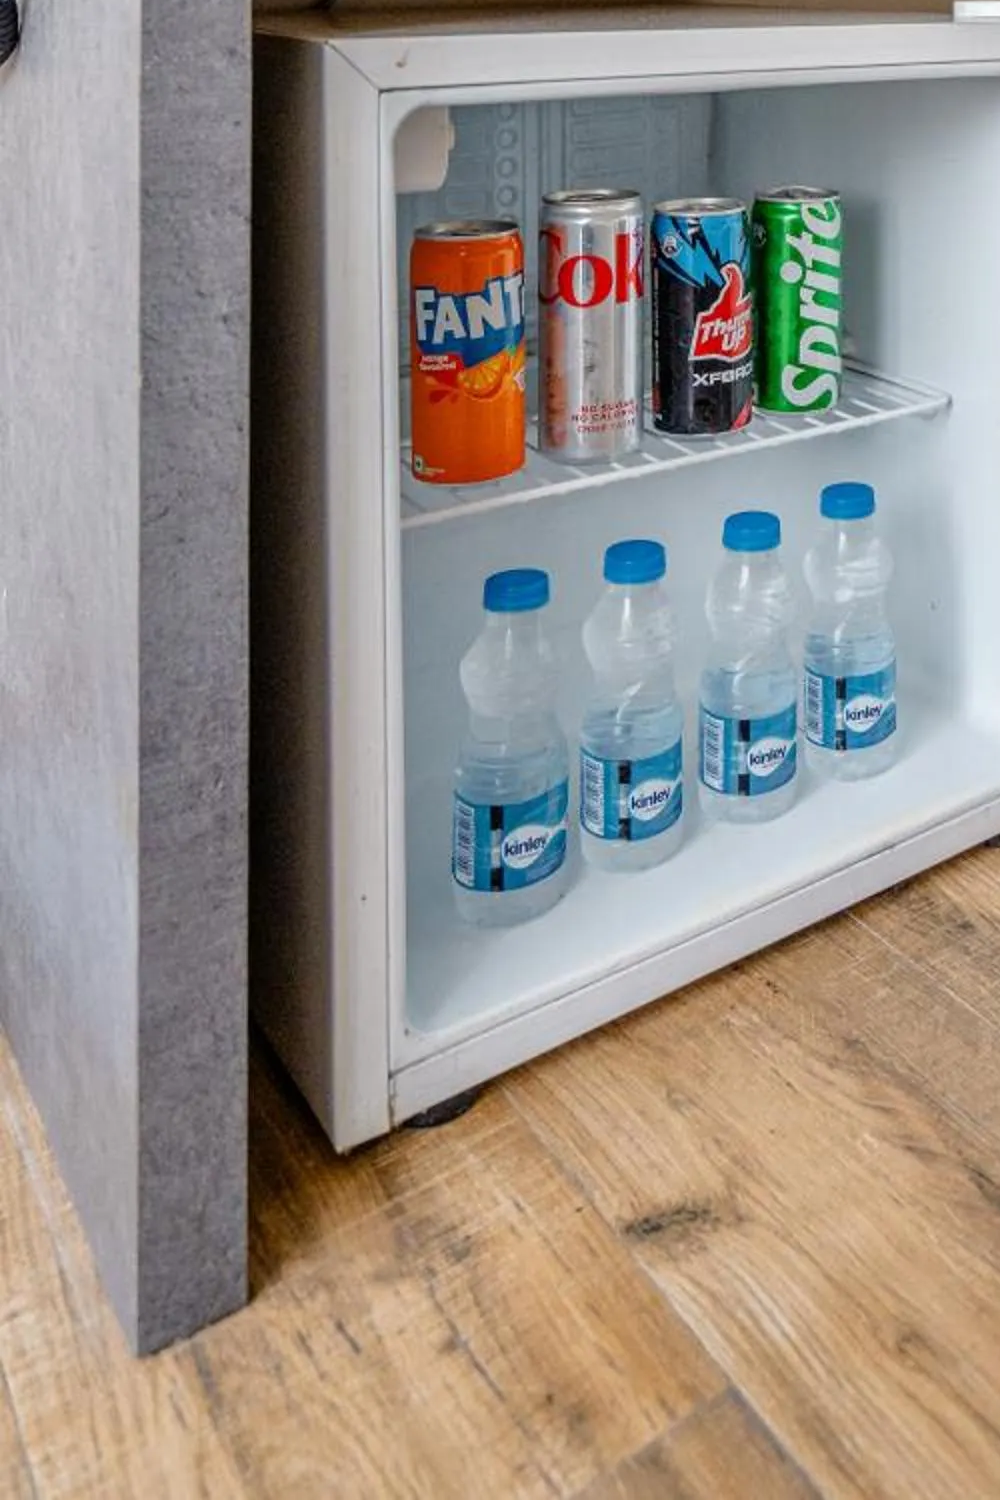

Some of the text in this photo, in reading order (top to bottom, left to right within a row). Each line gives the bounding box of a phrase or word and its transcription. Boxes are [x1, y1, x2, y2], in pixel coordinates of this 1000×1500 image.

[539, 228, 644, 309] Cok
[415, 274, 525, 344] FANT
[780, 199, 841, 409] Sprite
[692, 363, 753, 387] XFORC
[846, 704, 883, 721] kinley
[750, 745, 786, 765] kinley
[631, 787, 671, 810] kinley
[504, 833, 548, 857] kinley
